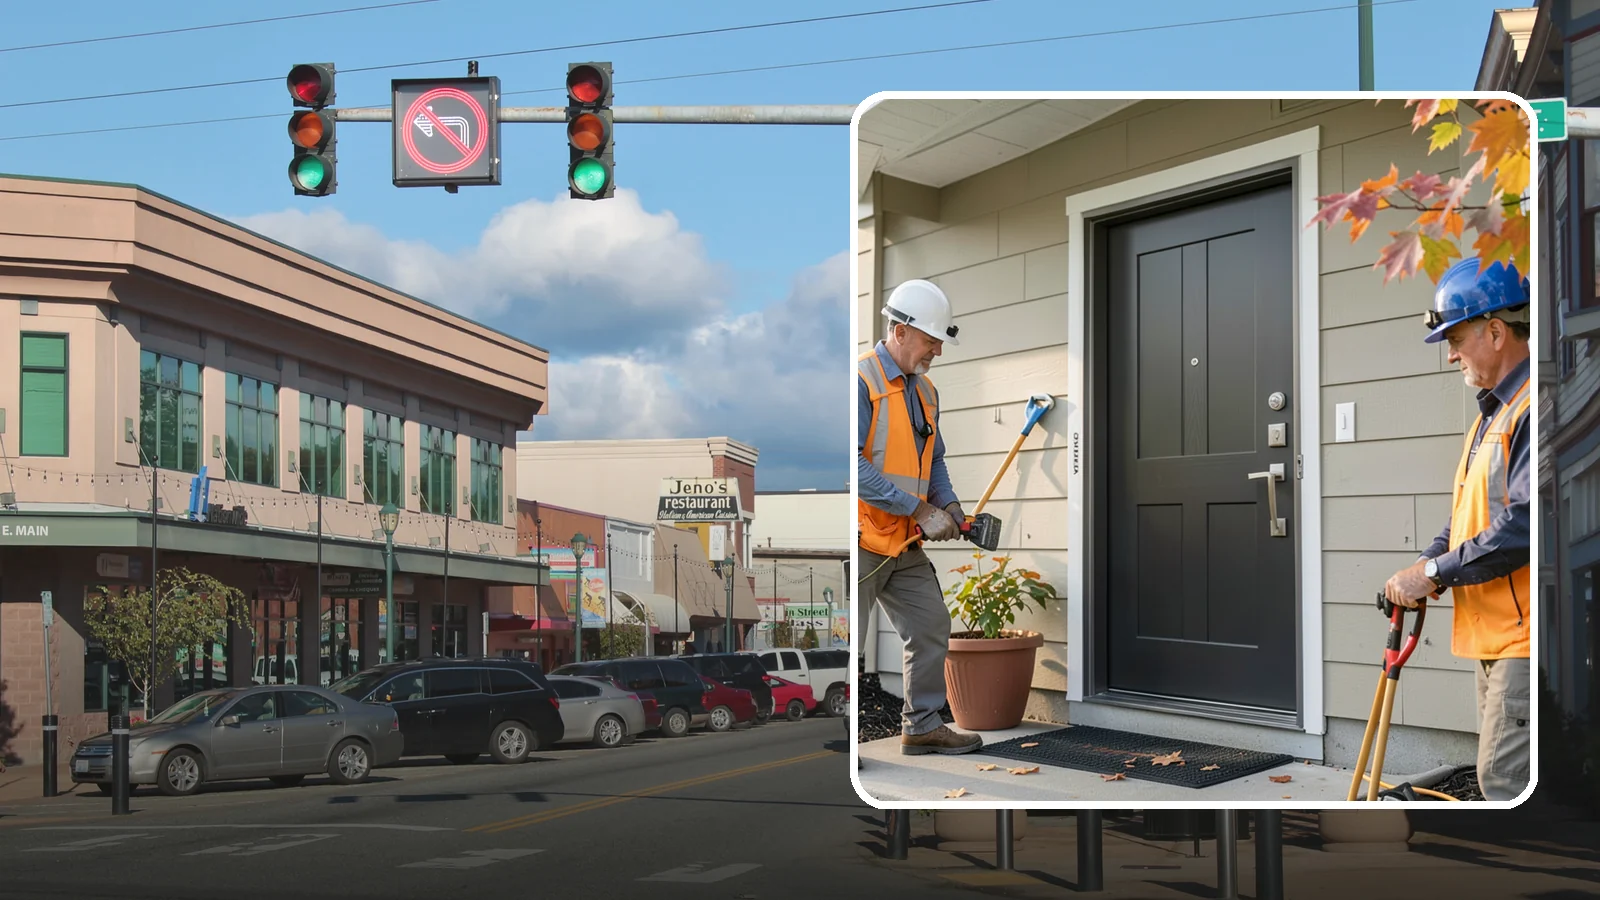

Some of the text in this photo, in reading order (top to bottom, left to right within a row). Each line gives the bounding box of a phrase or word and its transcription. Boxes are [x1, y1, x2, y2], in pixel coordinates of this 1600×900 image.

[670, 480, 727, 494] Jeno's
[665, 496, 731, 509] restaurant
[659, 510, 681, 519] Italian
[686, 510, 714, 519] American
[715, 509, 738, 519] Cuisine
[2, 525, 49, 536] E. MAIN
[797, 607, 828, 617] Street
